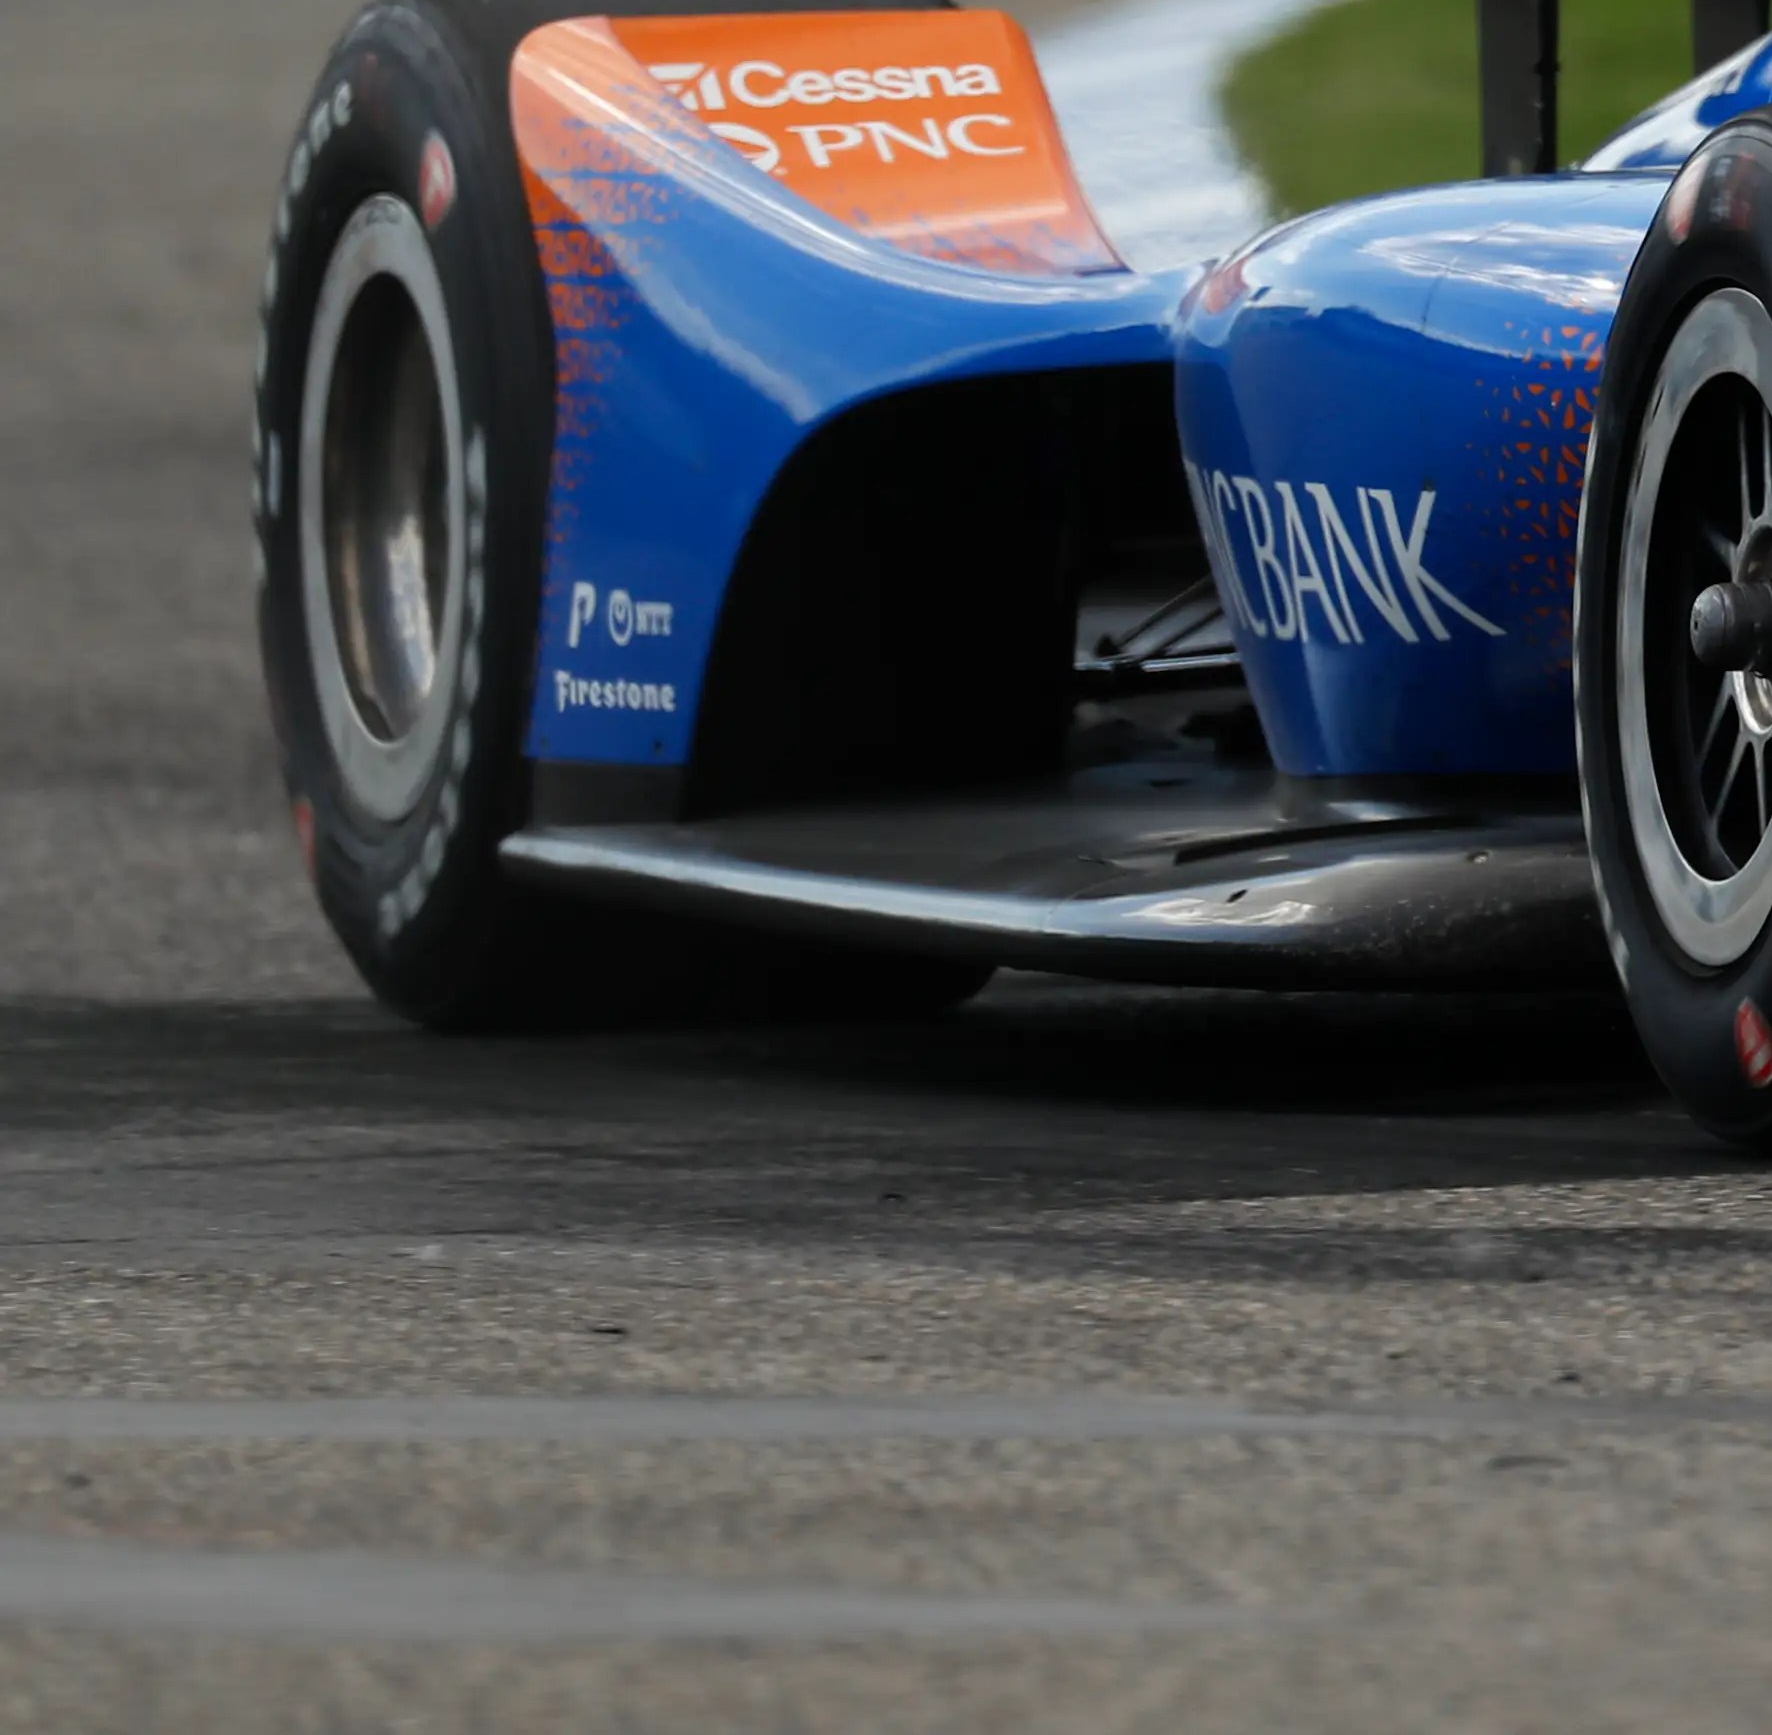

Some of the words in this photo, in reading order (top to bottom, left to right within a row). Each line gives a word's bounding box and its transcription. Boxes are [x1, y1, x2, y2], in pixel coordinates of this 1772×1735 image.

[728, 60, 1002, 108] Cessna
[785, 113, 1025, 169] PNC
[1231, 475, 1507, 645] BANK
[555, 669, 676, 713] Firestone
